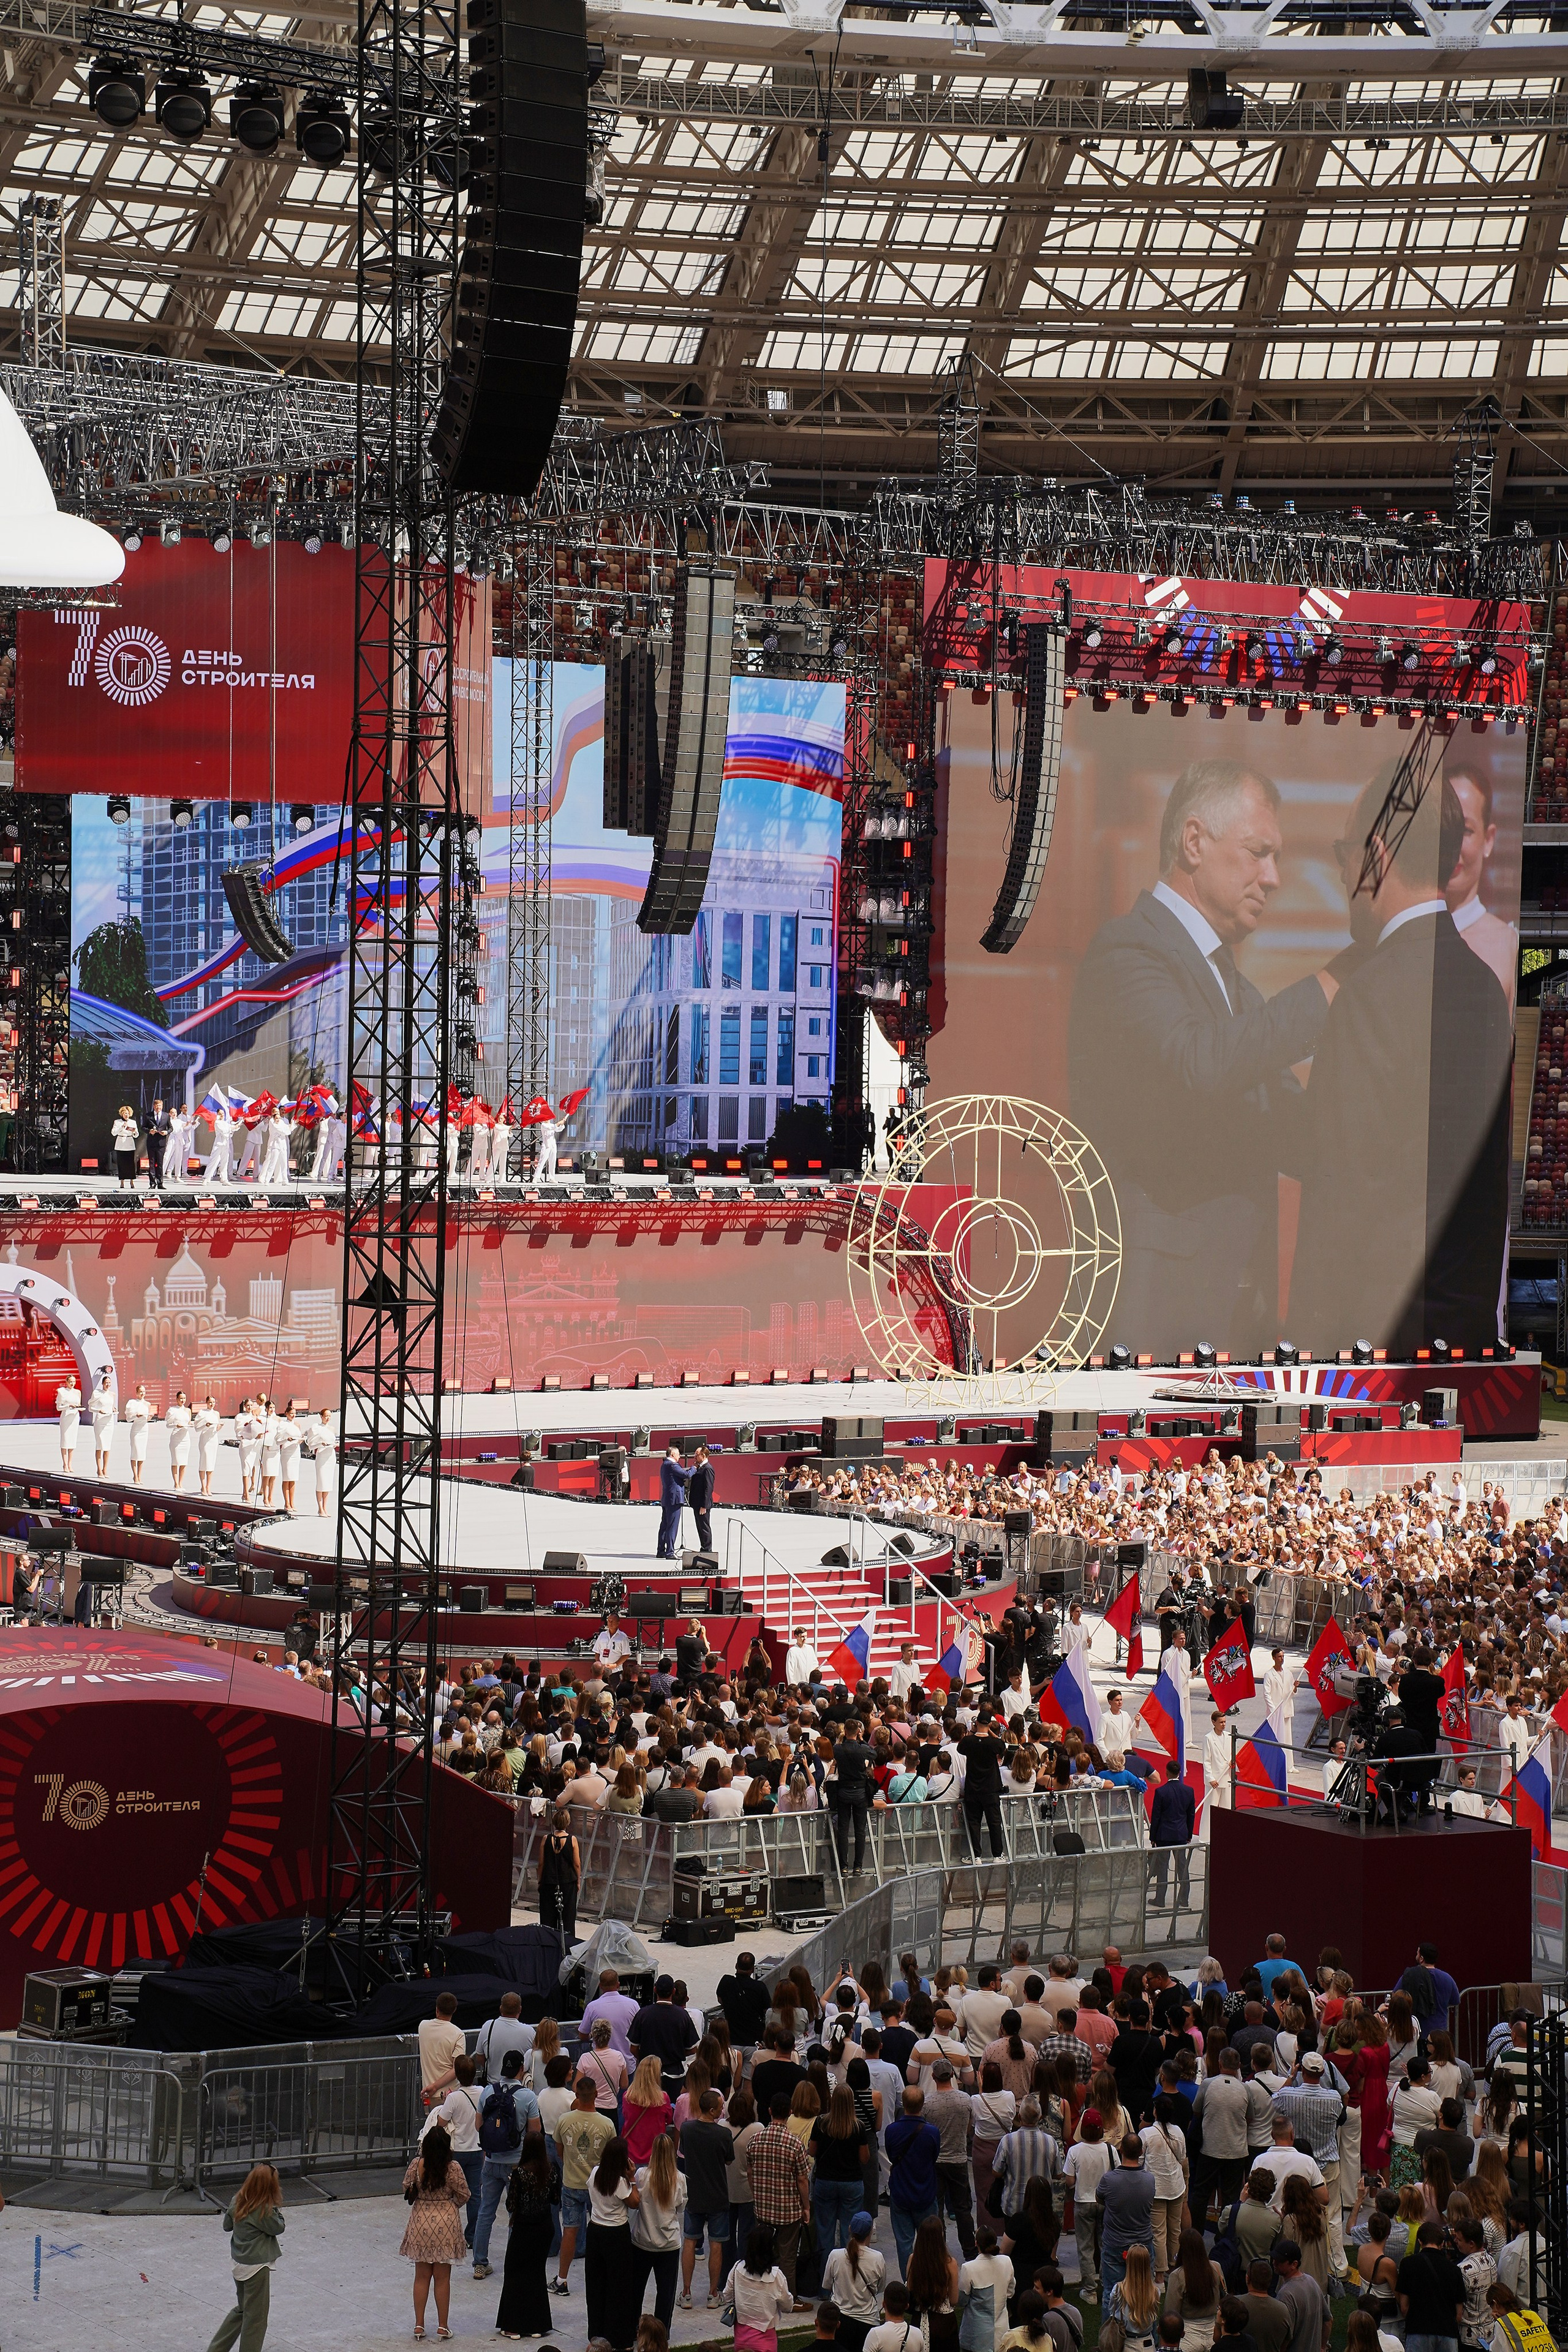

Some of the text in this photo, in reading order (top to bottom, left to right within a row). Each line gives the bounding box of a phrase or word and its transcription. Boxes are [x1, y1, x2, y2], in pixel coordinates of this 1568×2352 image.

[182, 649, 243, 666] ДЕНЬ
[181, 669, 315, 689] СТРОИТЕЛЯ
[116, 1790, 155, 1801] ДЕНЬ
[116, 1800, 200, 1814] СТРОИТЕЛЯ
[1520, 2324, 1545, 2337] SAFETY
